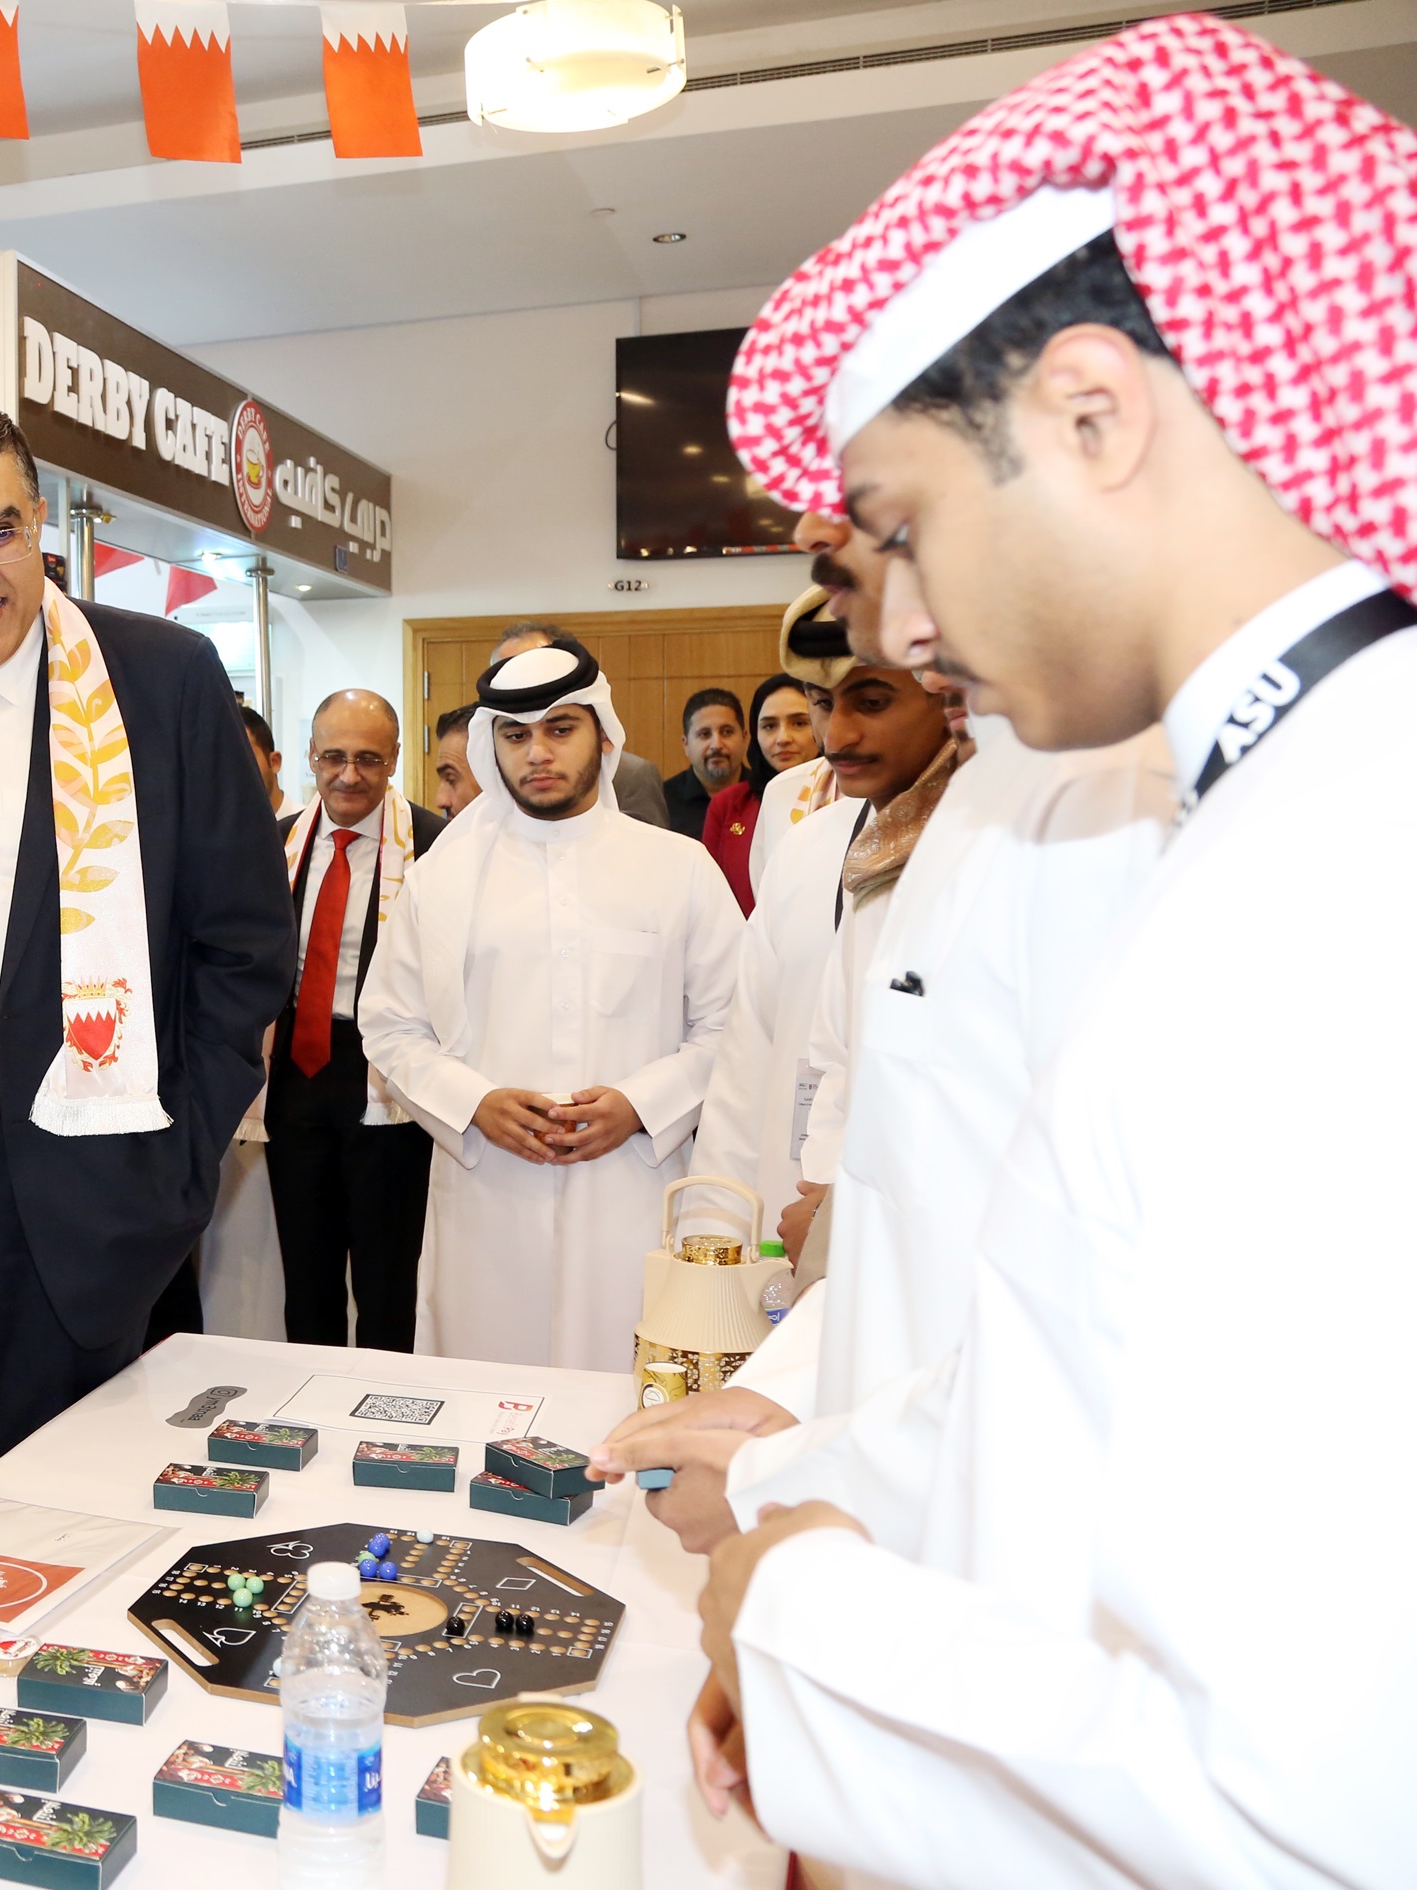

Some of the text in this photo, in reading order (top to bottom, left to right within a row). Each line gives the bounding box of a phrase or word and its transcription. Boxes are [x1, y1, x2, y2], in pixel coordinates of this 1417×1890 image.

[23, 315, 231, 487] DERBY CAFE
[273, 456, 392, 562] دربي كافيه
[614, 579, 642, 591] G12
[1216, 660, 1301, 764] ASU
